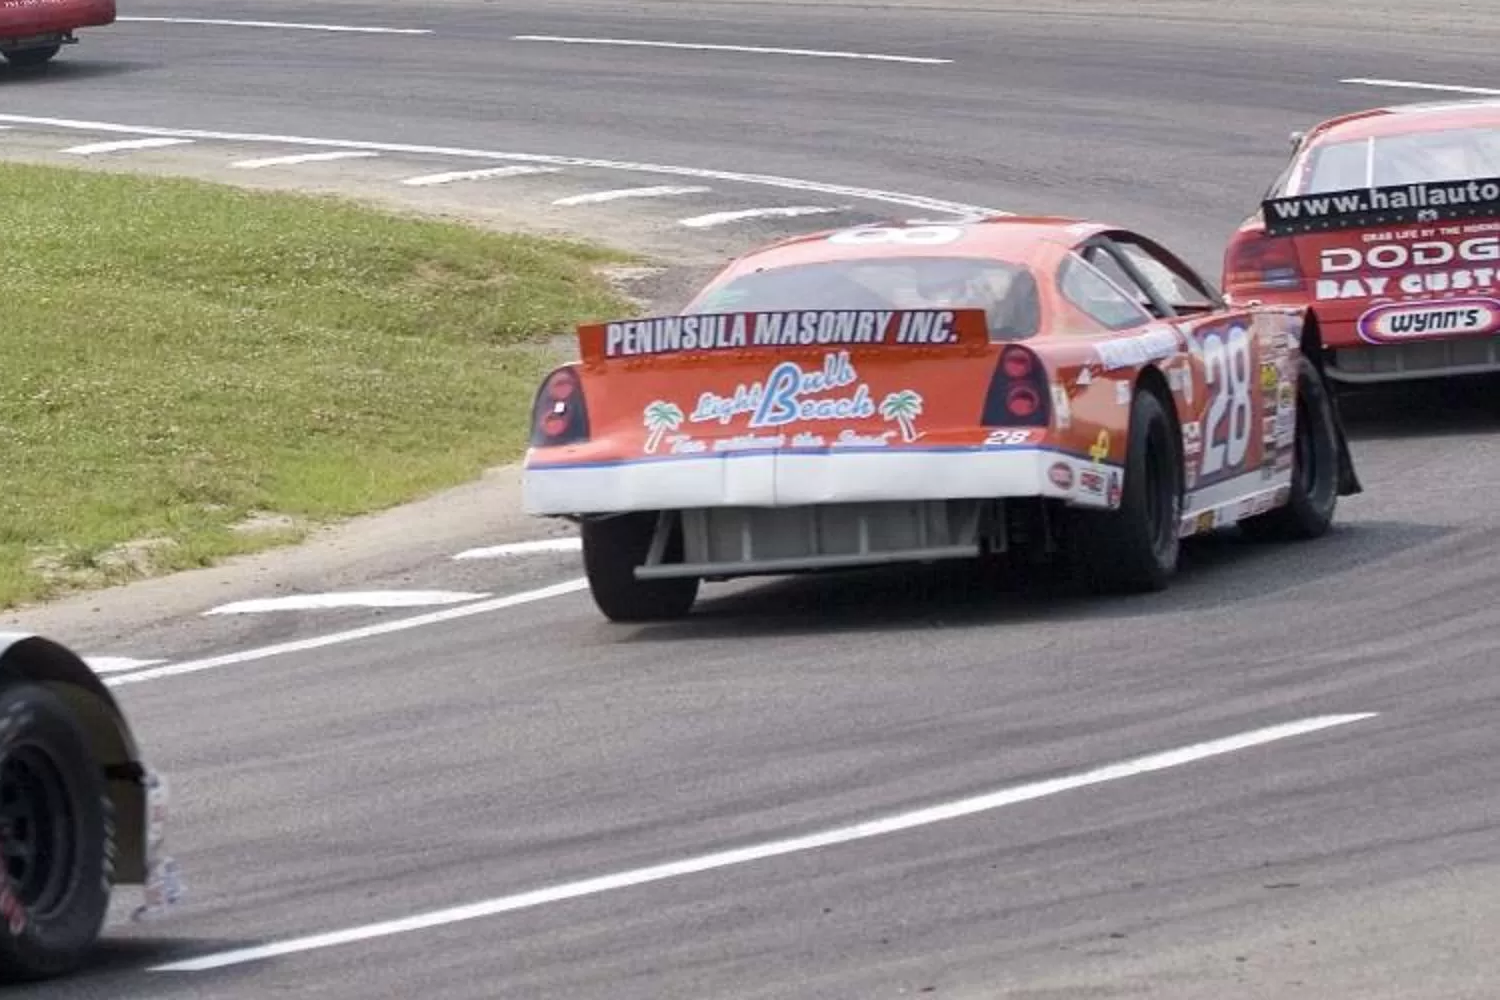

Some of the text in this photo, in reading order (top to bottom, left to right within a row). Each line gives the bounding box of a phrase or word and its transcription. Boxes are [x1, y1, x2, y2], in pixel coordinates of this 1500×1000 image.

[1316, 277, 1388, 300] BAY
[607, 309, 959, 355] PENINSULA MASONRY INC.
[1201, 326, 1251, 477] 28
[984, 431, 1031, 444] 28
